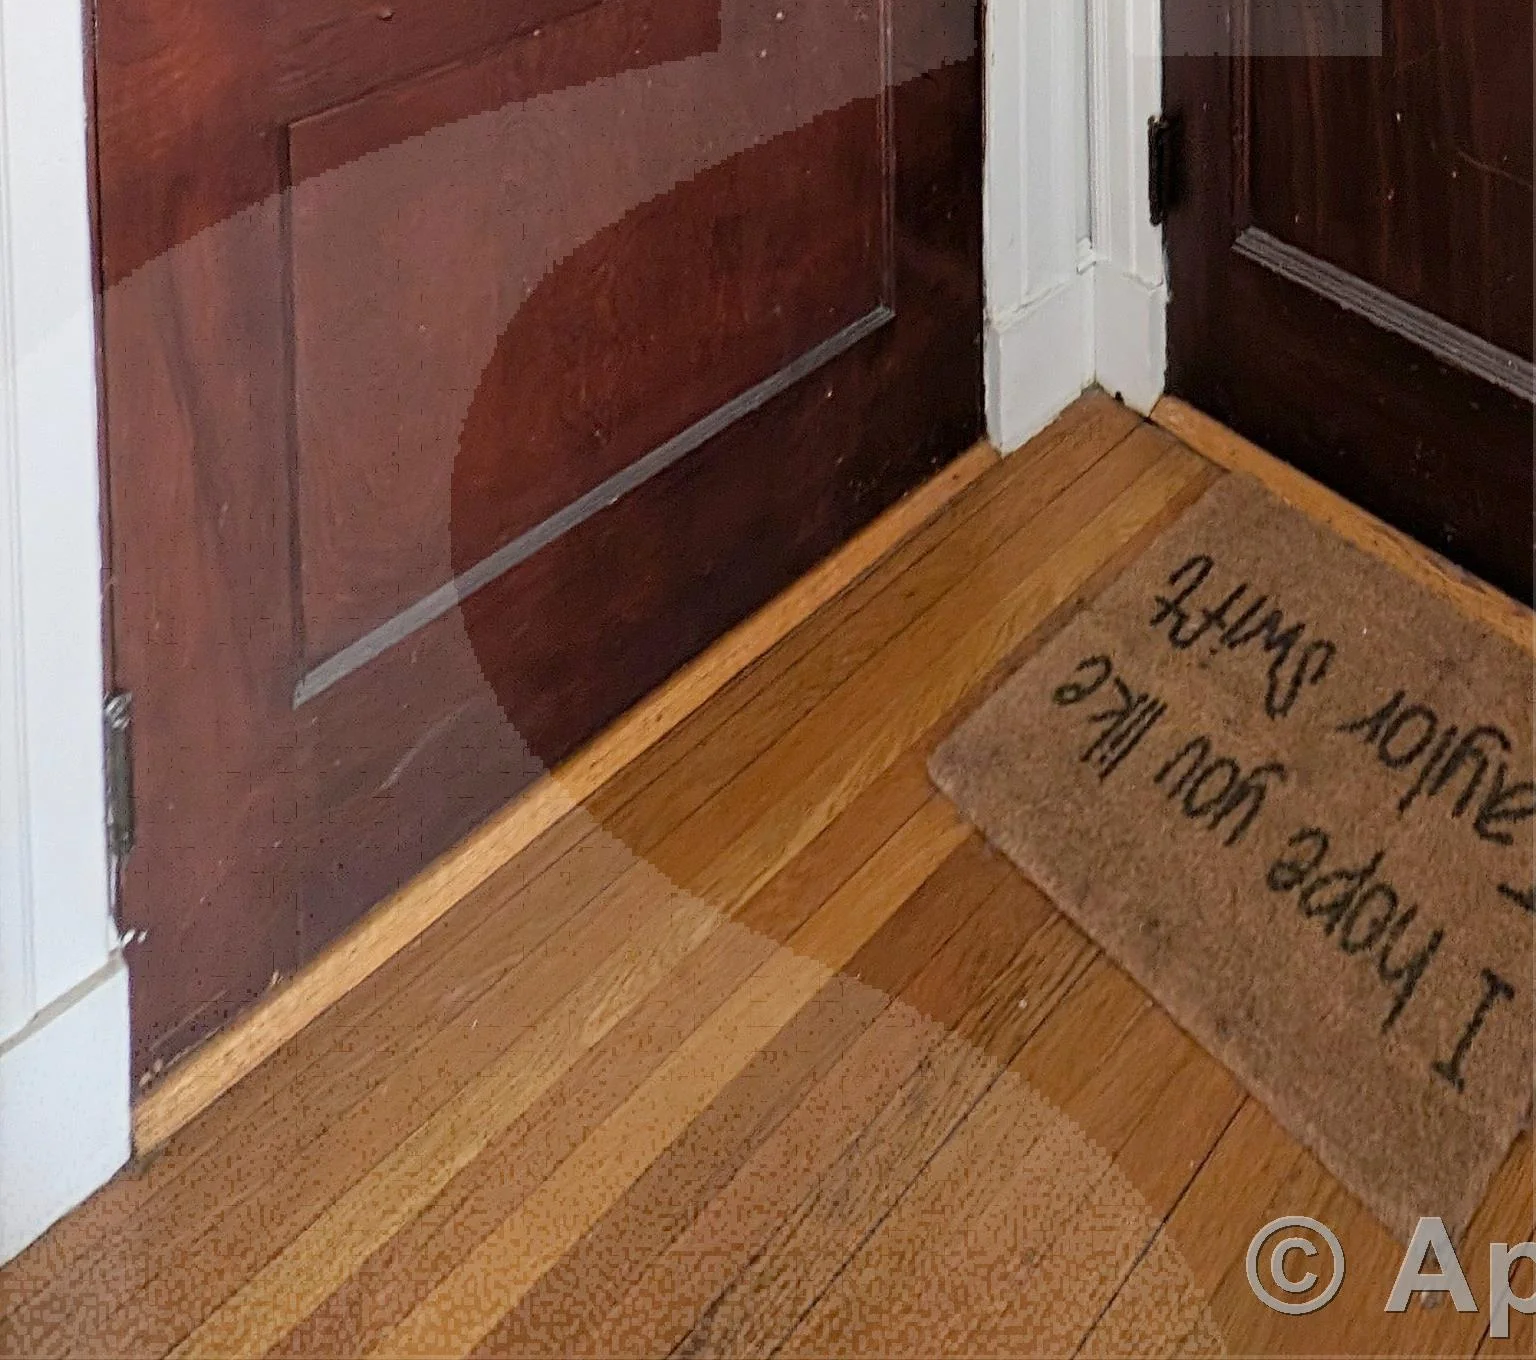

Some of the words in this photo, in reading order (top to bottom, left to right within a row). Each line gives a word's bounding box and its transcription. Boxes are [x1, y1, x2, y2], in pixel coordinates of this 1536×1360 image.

[1150, 553, 1336, 721] Swift
[1052, 655, 1168, 783] like
[1153, 735, 1288, 848] you
[1266, 826, 1444, 1035] hope
[1432, 966, 1516, 1095] I
